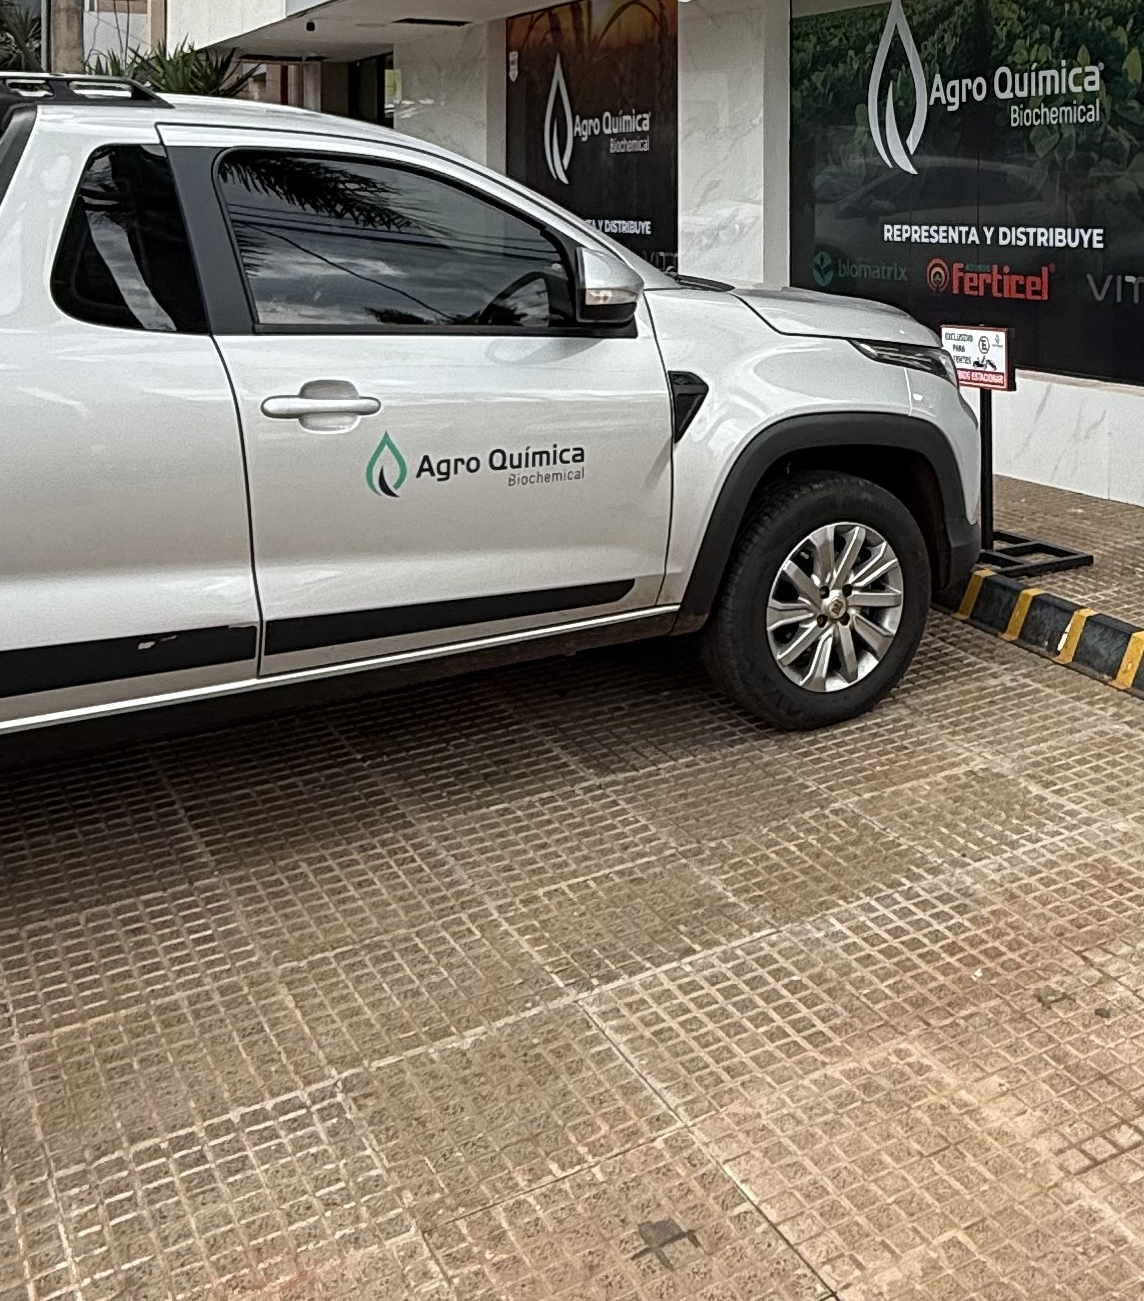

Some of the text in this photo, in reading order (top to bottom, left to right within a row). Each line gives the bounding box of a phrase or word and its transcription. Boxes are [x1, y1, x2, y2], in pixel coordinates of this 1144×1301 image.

[929, 60, 1101, 112] Agro Química
[1010, 98, 1100, 127] Biochemical
[573, 114, 600, 142] Agro
[883, 224, 1104, 249] REPRESENTA Y DISTRIBUYE
[838, 258, 909, 282] biomatrix
[415, 444, 585, 482] Agro Química
[508, 467, 585, 487] Biochemical
